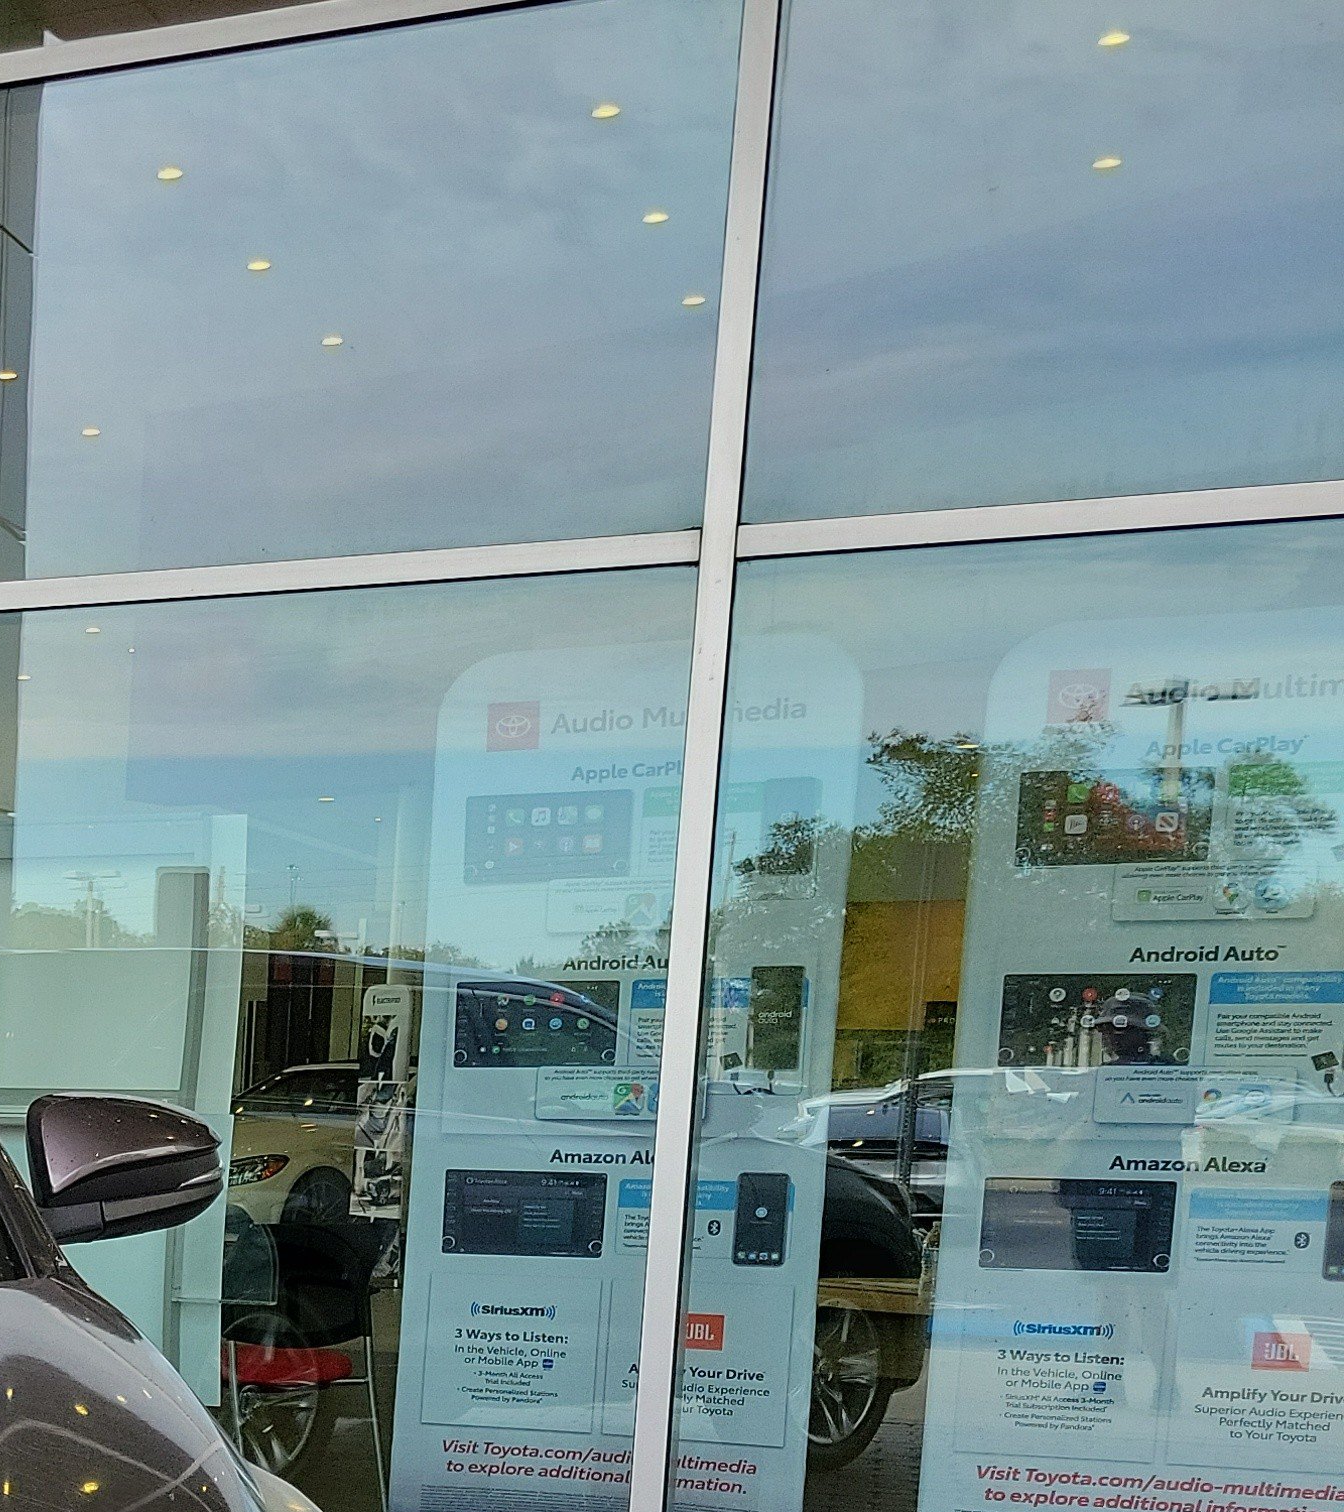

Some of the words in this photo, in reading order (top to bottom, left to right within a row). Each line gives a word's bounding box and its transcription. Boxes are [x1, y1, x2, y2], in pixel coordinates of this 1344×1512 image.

[551, 710, 633, 734] Audio
[642, 698, 807, 728] Mumedia
[1146, 738, 1212, 760] Apple
[571, 764, 628, 784] Apple
[632, 759, 683, 778] CarPl
[1129, 945, 1220, 963] Android
[563, 954, 639, 971] Android
[642, 955, 670, 970] Au
[549, 1149, 628, 1165] Amazon
[1109, 1155, 1200, 1173] Amazon
[454, 1328, 463, 1339] 3
[466, 1328, 502, 1343] Ways
[505, 1331, 520, 1342] to
[522, 1331, 569, 1345] Listen:
[454, 1344, 465, 1353] In
[467, 1345, 484, 1354] the
[487, 1346, 527, 1358] Vehicle,
[530, 1348, 567, 1359] Online
[997, 1349, 1006, 1360] 3
[1010, 1349, 1051, 1363] Ways
[1054, 1352, 1070, 1363] to
[1074, 1352, 1125, 1366] Listen:
[1264, 1342, 1300, 1361] JBL
[477, 1356, 513, 1366] Mobile
[516, 1358, 539, 1369] App
[689, 1366, 723, 1379] Your
[726, 1368, 765, 1381] Drive
[997, 1366, 1008, 1376] In
[1011, 1367, 1030, 1377] the
[1033, 1368, 1078, 1380] Vehicle,
[1082, 1370, 1122, 1381] Online
[707, 1385, 770, 1397] Experience
[1020, 1379, 1062, 1390] Mobile
[1064, 1380, 1089, 1392] App
[695, 1394, 745, 1406] Matched
[1202, 1386, 1267, 1402] Amplify
[1270, 1389, 1308, 1402] Your
[697, 1405, 734, 1417] Toyota
[1194, 1403, 1246, 1416] Superior
[1249, 1406, 1286, 1418] Audio
[1219, 1417, 1273, 1431] Perfectly
[1275, 1420, 1331, 1431] Matched
[1230, 1430, 1243, 1439] to
[1245, 1430, 1274, 1440] Your
[1276, 1431, 1317, 1444] Toyota
[442, 1439, 480, 1455] Visit
[446, 1459, 465, 1473] to
[468, 1461, 534, 1478] explore
[538, 1466, 631, 1485] additional
[976, 1465, 1021, 1482] Visit
[984, 1487, 1007, 1502] to
[1010, 1490, 1091, 1508] explore
